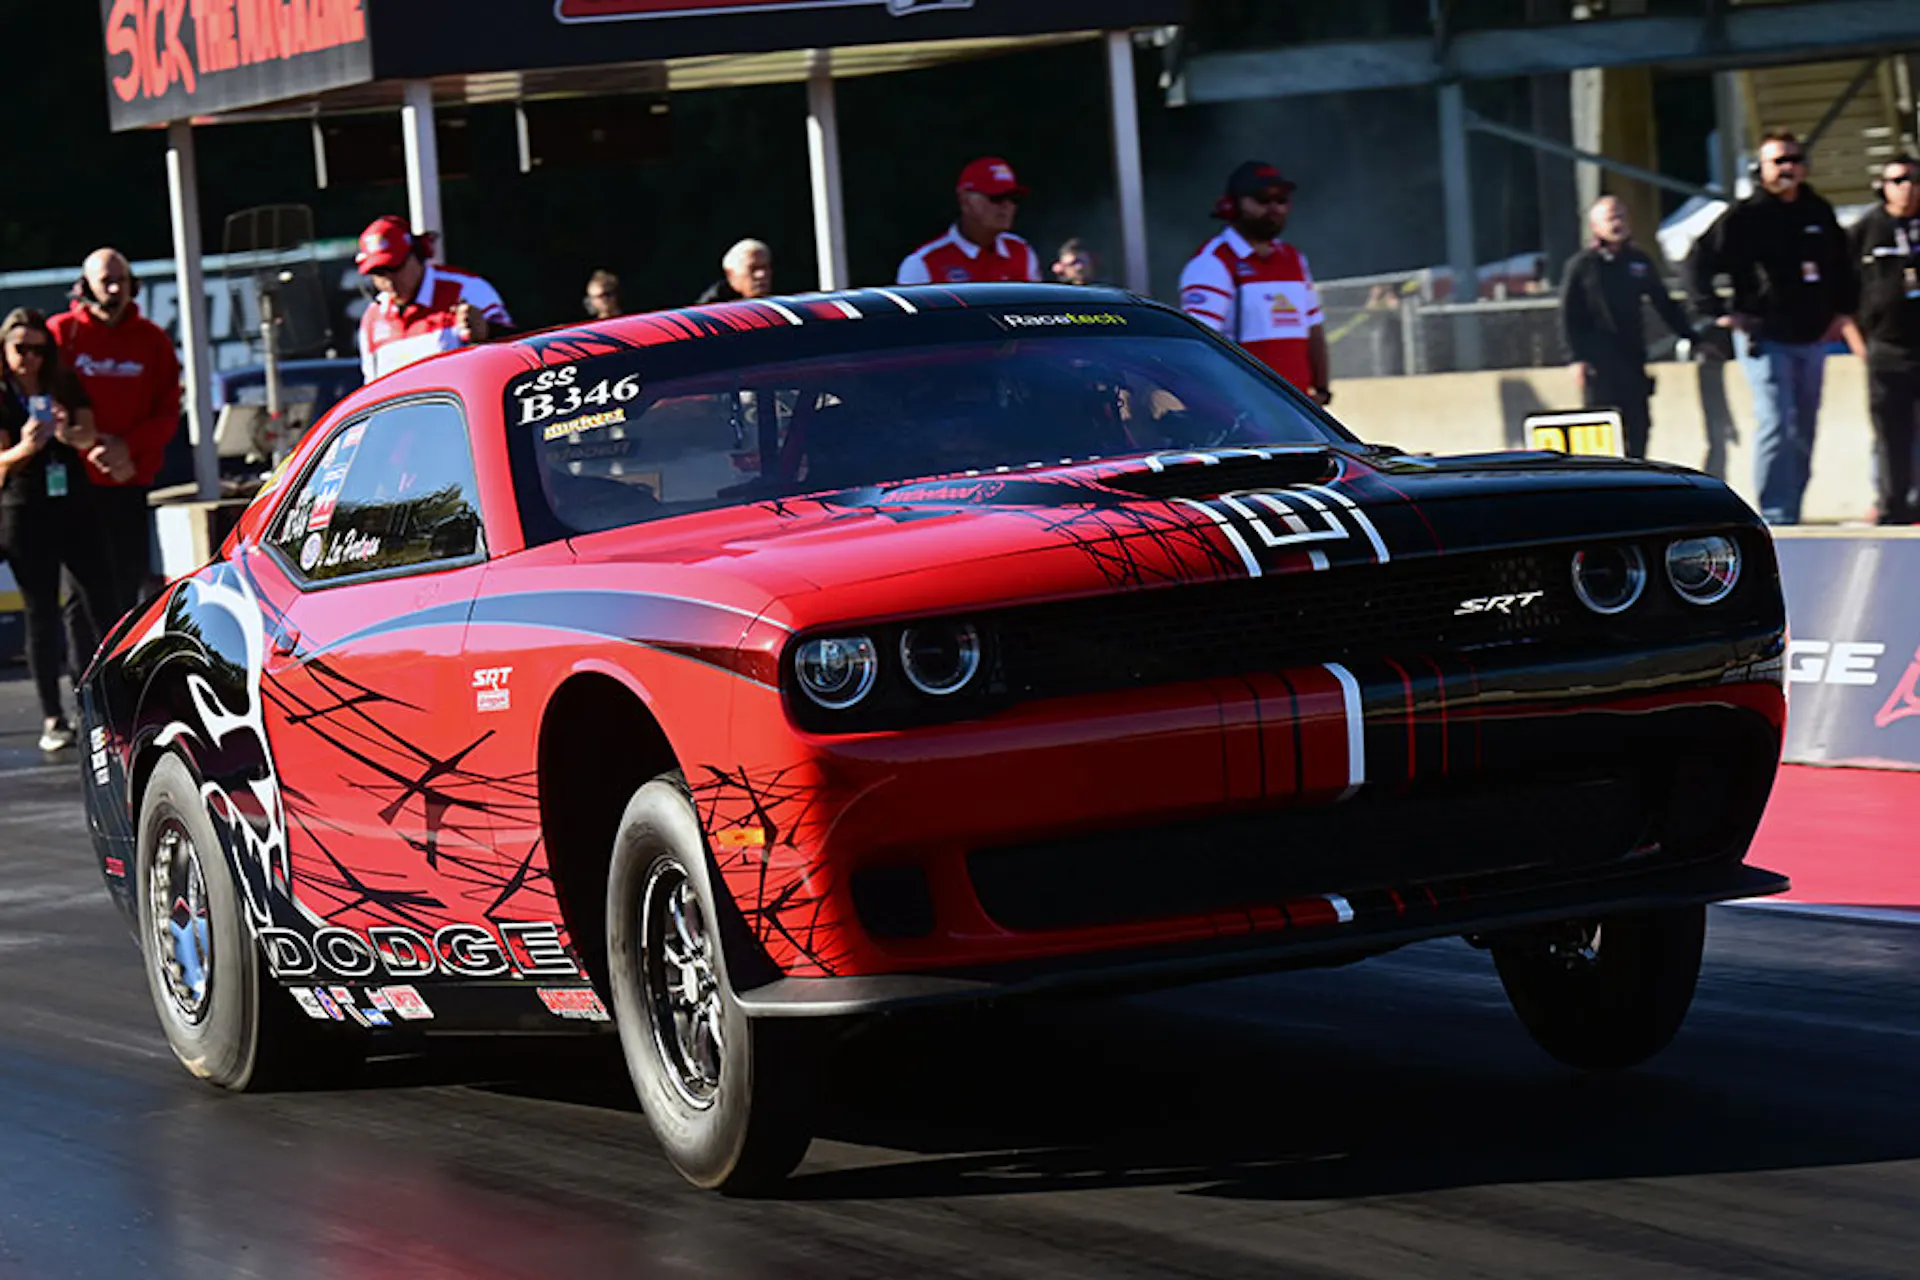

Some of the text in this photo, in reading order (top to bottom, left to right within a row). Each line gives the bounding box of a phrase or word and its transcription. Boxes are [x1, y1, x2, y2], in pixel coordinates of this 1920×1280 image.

[105, 0, 196, 101] SICK
[191, 0, 239, 74] THE
[1003, 312, 1127, 328] Racetech
[516, 372, 640, 426] B346
[1453, 589, 1545, 616] SRT
[472, 665, 514, 691] SRT
[257, 921, 580, 977] DODGE
